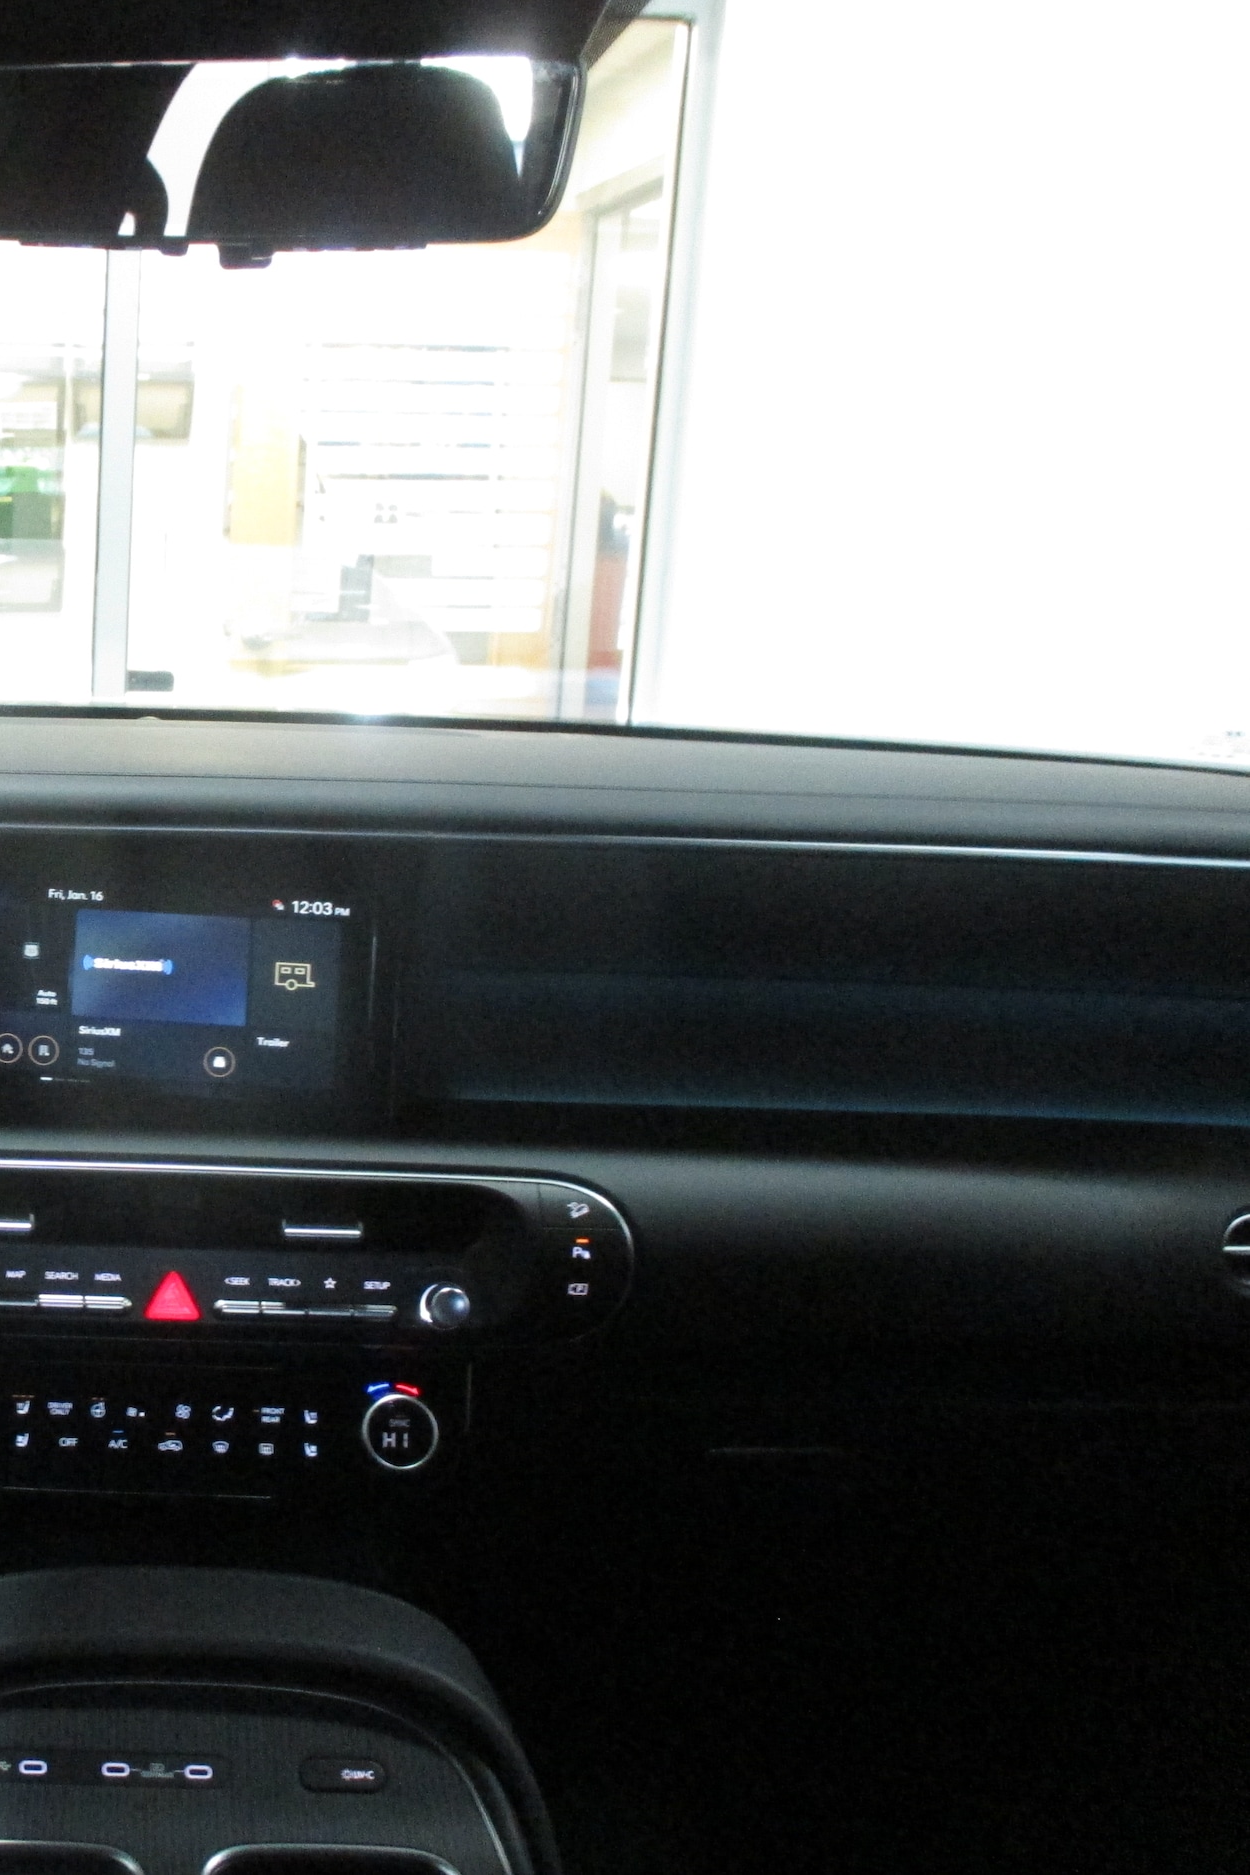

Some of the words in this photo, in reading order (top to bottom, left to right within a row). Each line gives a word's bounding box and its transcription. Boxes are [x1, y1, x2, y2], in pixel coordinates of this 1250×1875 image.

[47, 887, 65, 901] Fri,
[67, 889, 88, 901] Jan.
[90, 890, 104, 902] 16
[291, 900, 334, 916] 12:03
[334, 907, 350, 917] PM
[93, 957, 163, 972] SiriusXM
[78, 1025, 121, 1036] SiriusXM
[257, 1036, 290, 1049] Trailer
[5, 1270, 26, 1279] MAP
[44, 1271, 79, 1281] SEARCH
[94, 1273, 122, 1282] MEDIA
[363, 1281, 391, 1290] SETUP
[260, 1415, 280, 1423] REAR
[58, 1437, 79, 1447] OFF
[107, 1439, 128, 1449] A/C
